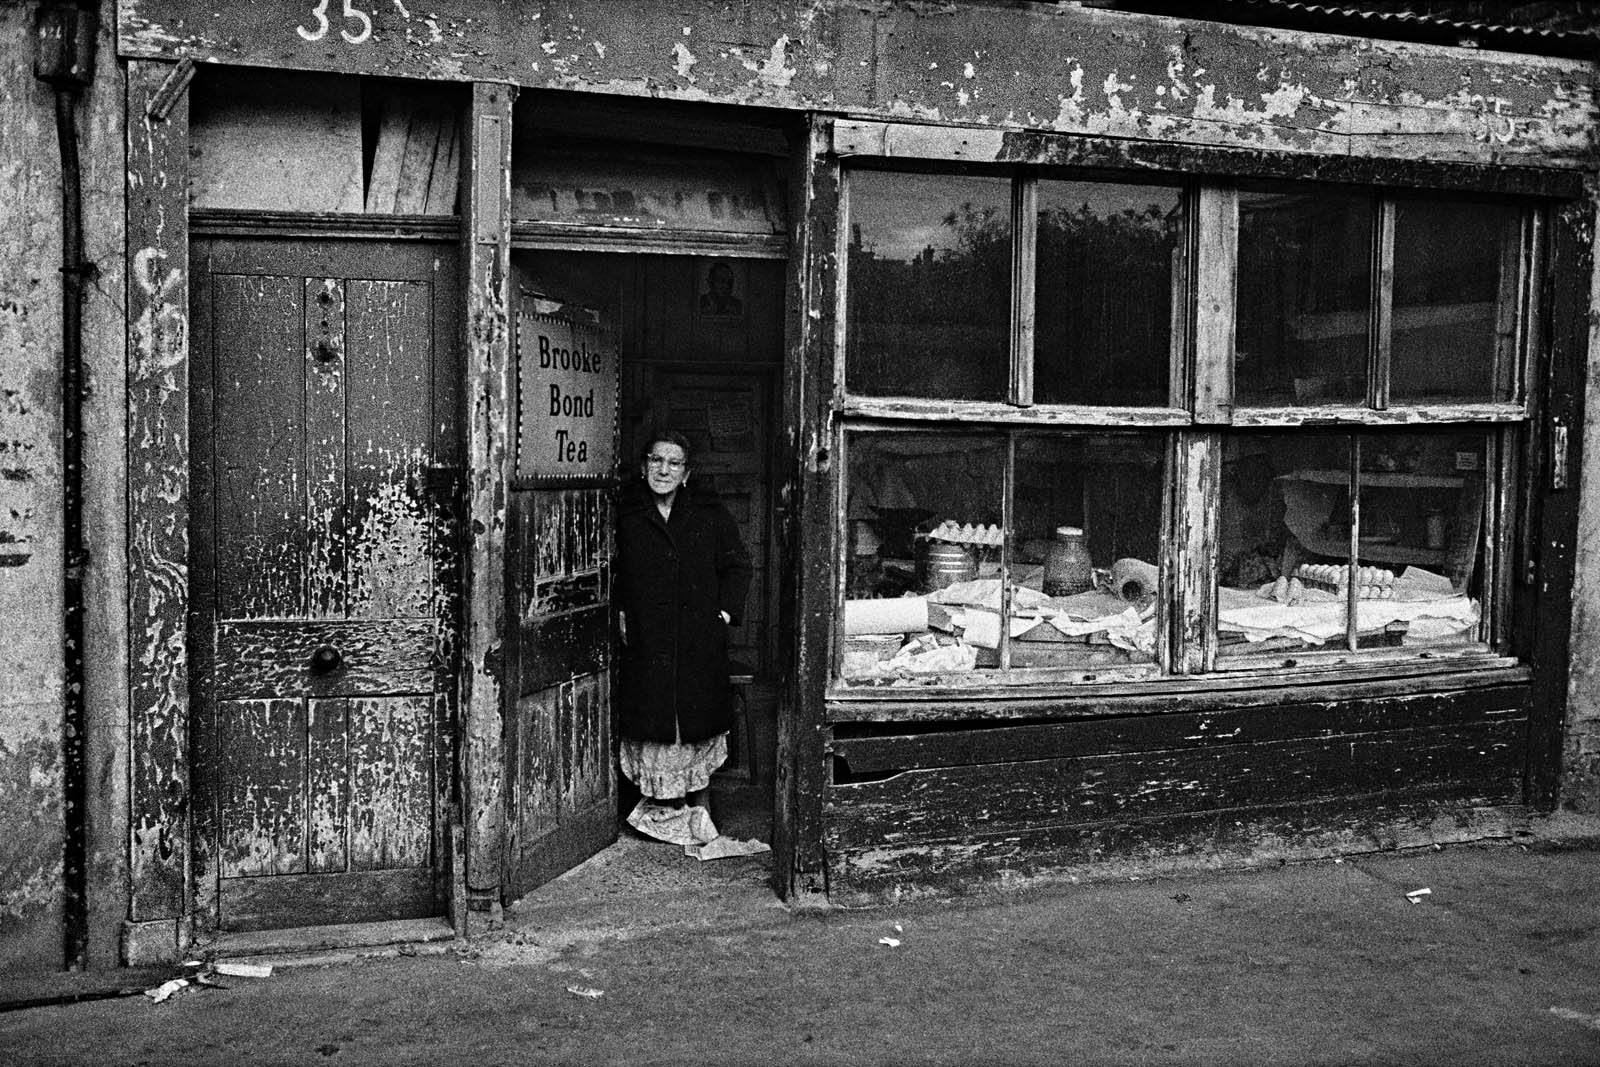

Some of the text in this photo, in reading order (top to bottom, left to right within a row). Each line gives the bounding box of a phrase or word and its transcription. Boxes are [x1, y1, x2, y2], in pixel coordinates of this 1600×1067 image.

[296, 0, 372, 44] 35
[538, 335, 601, 374] Brooke
[549, 383, 594, 418] Bond
[555, 429, 588, 462] Tea
